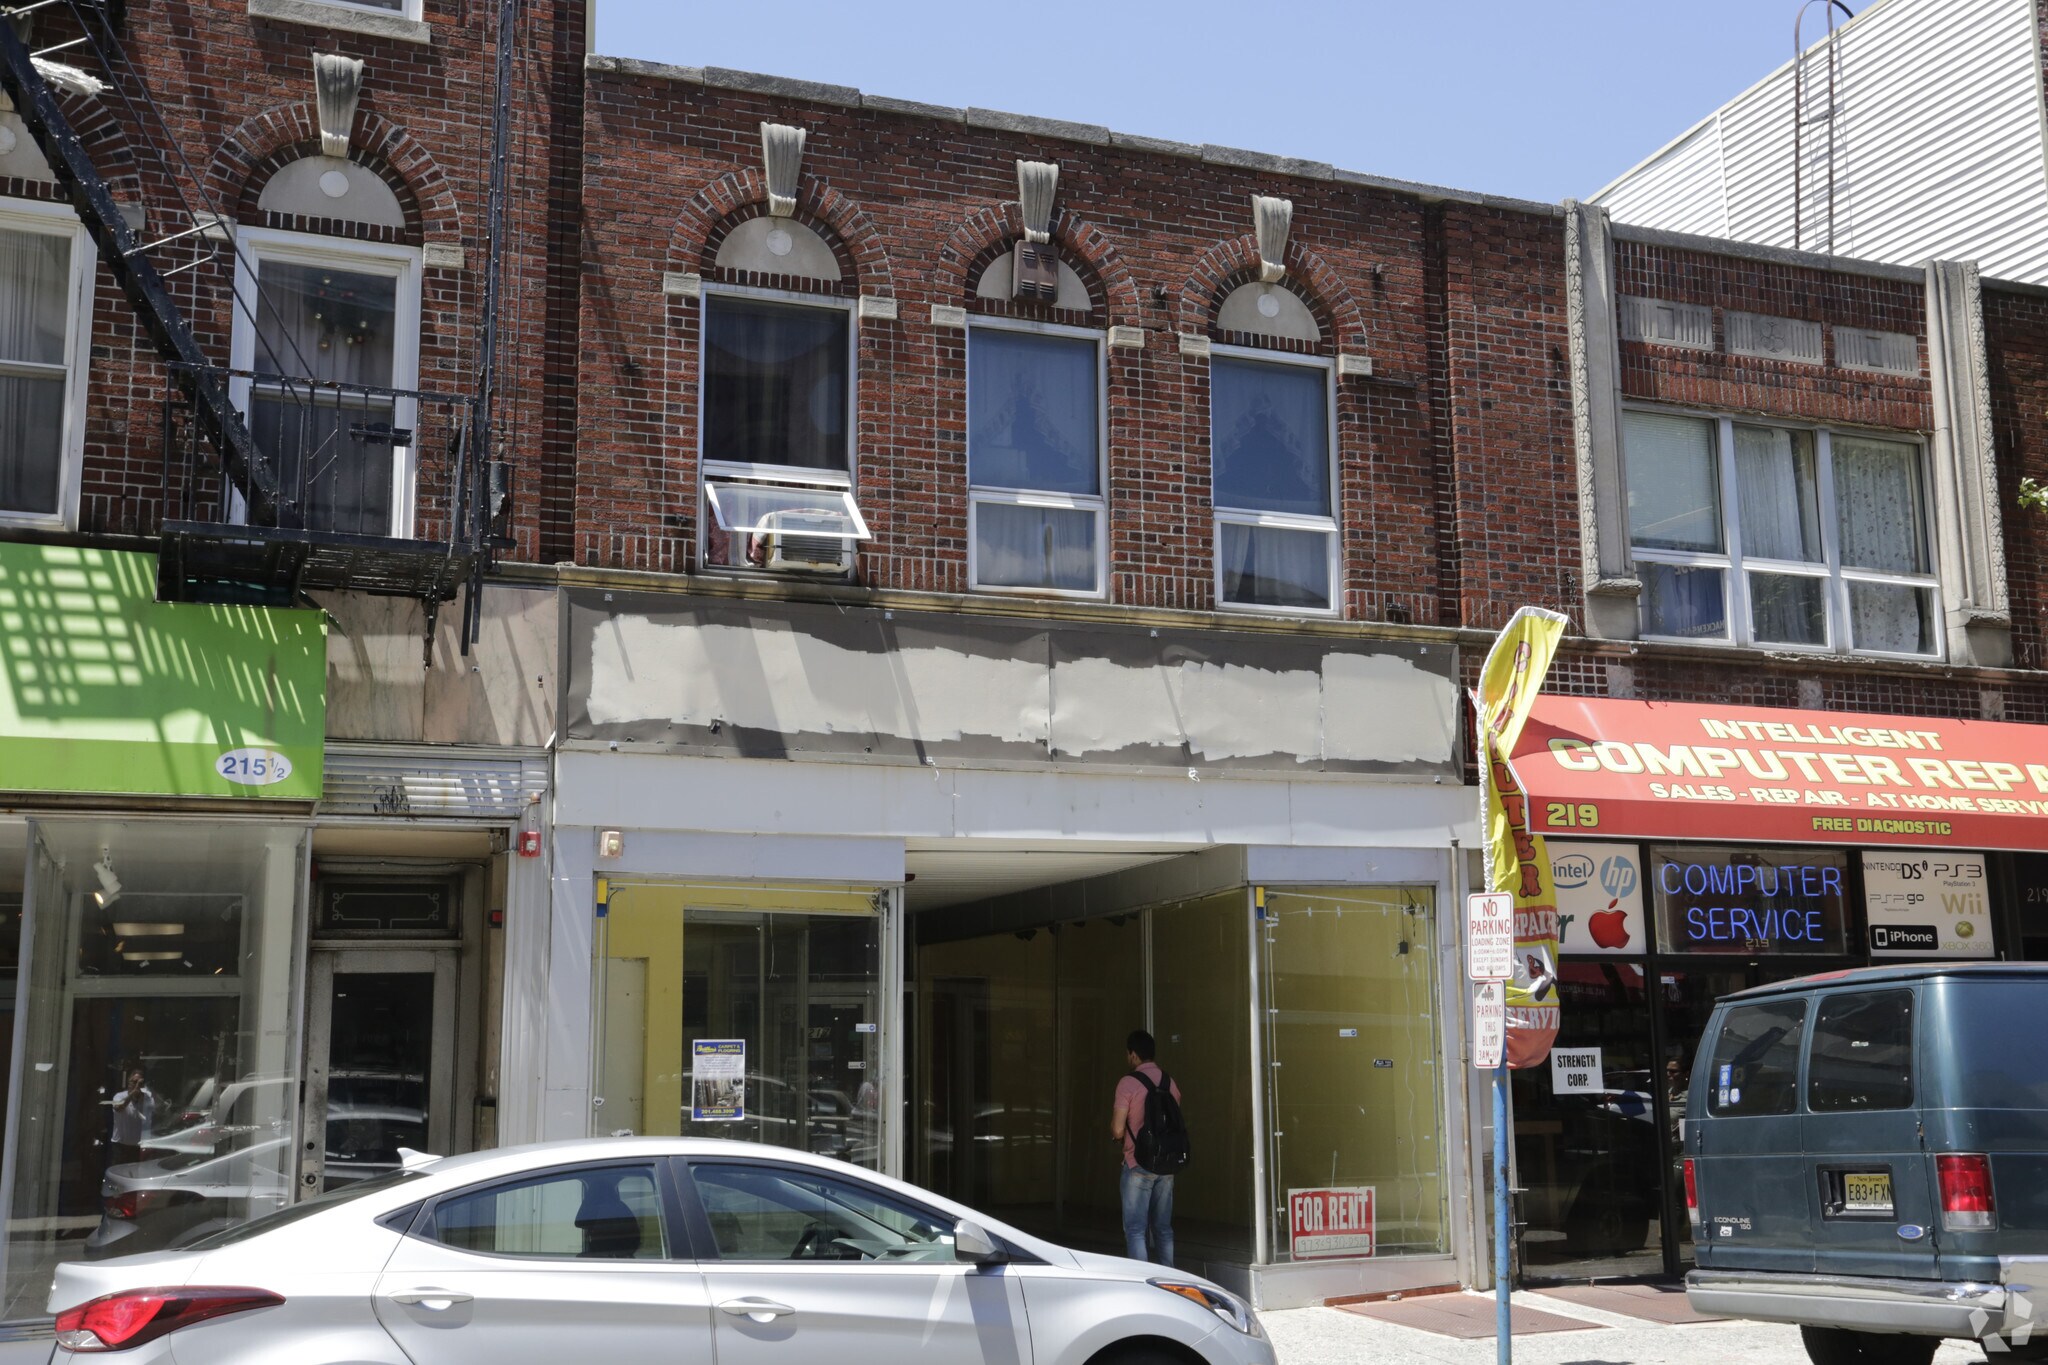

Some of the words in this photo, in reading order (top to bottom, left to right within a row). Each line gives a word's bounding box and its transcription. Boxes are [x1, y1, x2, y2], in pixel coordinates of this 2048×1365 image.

[1699, 718, 1944, 750] INTELLIGENT
[1547, 738, 1914, 787] COMPUTER
[1649, 782, 1736, 801] SALES
[1749, 787, 1849, 806] REPAIR
[1866, 792, 1900, 808] AT
[1900, 793, 1978, 812] HOME
[1546, 803, 1599, 827] 219
[1812, 816, 1853, 832] FREE
[1856, 818, 1952, 835] DIAGNOSTIC
[1553, 861, 1587, 878] intel
[1863, 862, 1901, 871] NINTENDO
[1934, 863, 1982, 878] PS3
[1604, 854, 1634, 898] hp
[1661, 863, 1842, 897] COMPUTER
[1483, 901, 1498, 917] NO
[1940, 892, 1983, 914] Wii
[1471, 919, 1510, 935] PARKING
[1687, 907, 1824, 941] SERVICE
[1472, 938, 1494, 946] LOADING
[1496, 937, 1510, 946] ZONE
[1745, 938, 1769, 948] 219
[1890, 930, 1933, 942] iPhone
[1941, 941, 1969, 951] XBOX
[1971, 941, 1993, 951] 360
[1476, 1004, 1502, 1018] PARKING
[1485, 1022, 1496, 1032] THIS
[1557, 1055, 1596, 1068] STRENGTH
[1567, 1073, 1589, 1086] CORP.
[1295, 1196, 1323, 1232] FOR
[1329, 1195, 1368, 1230] RENT
